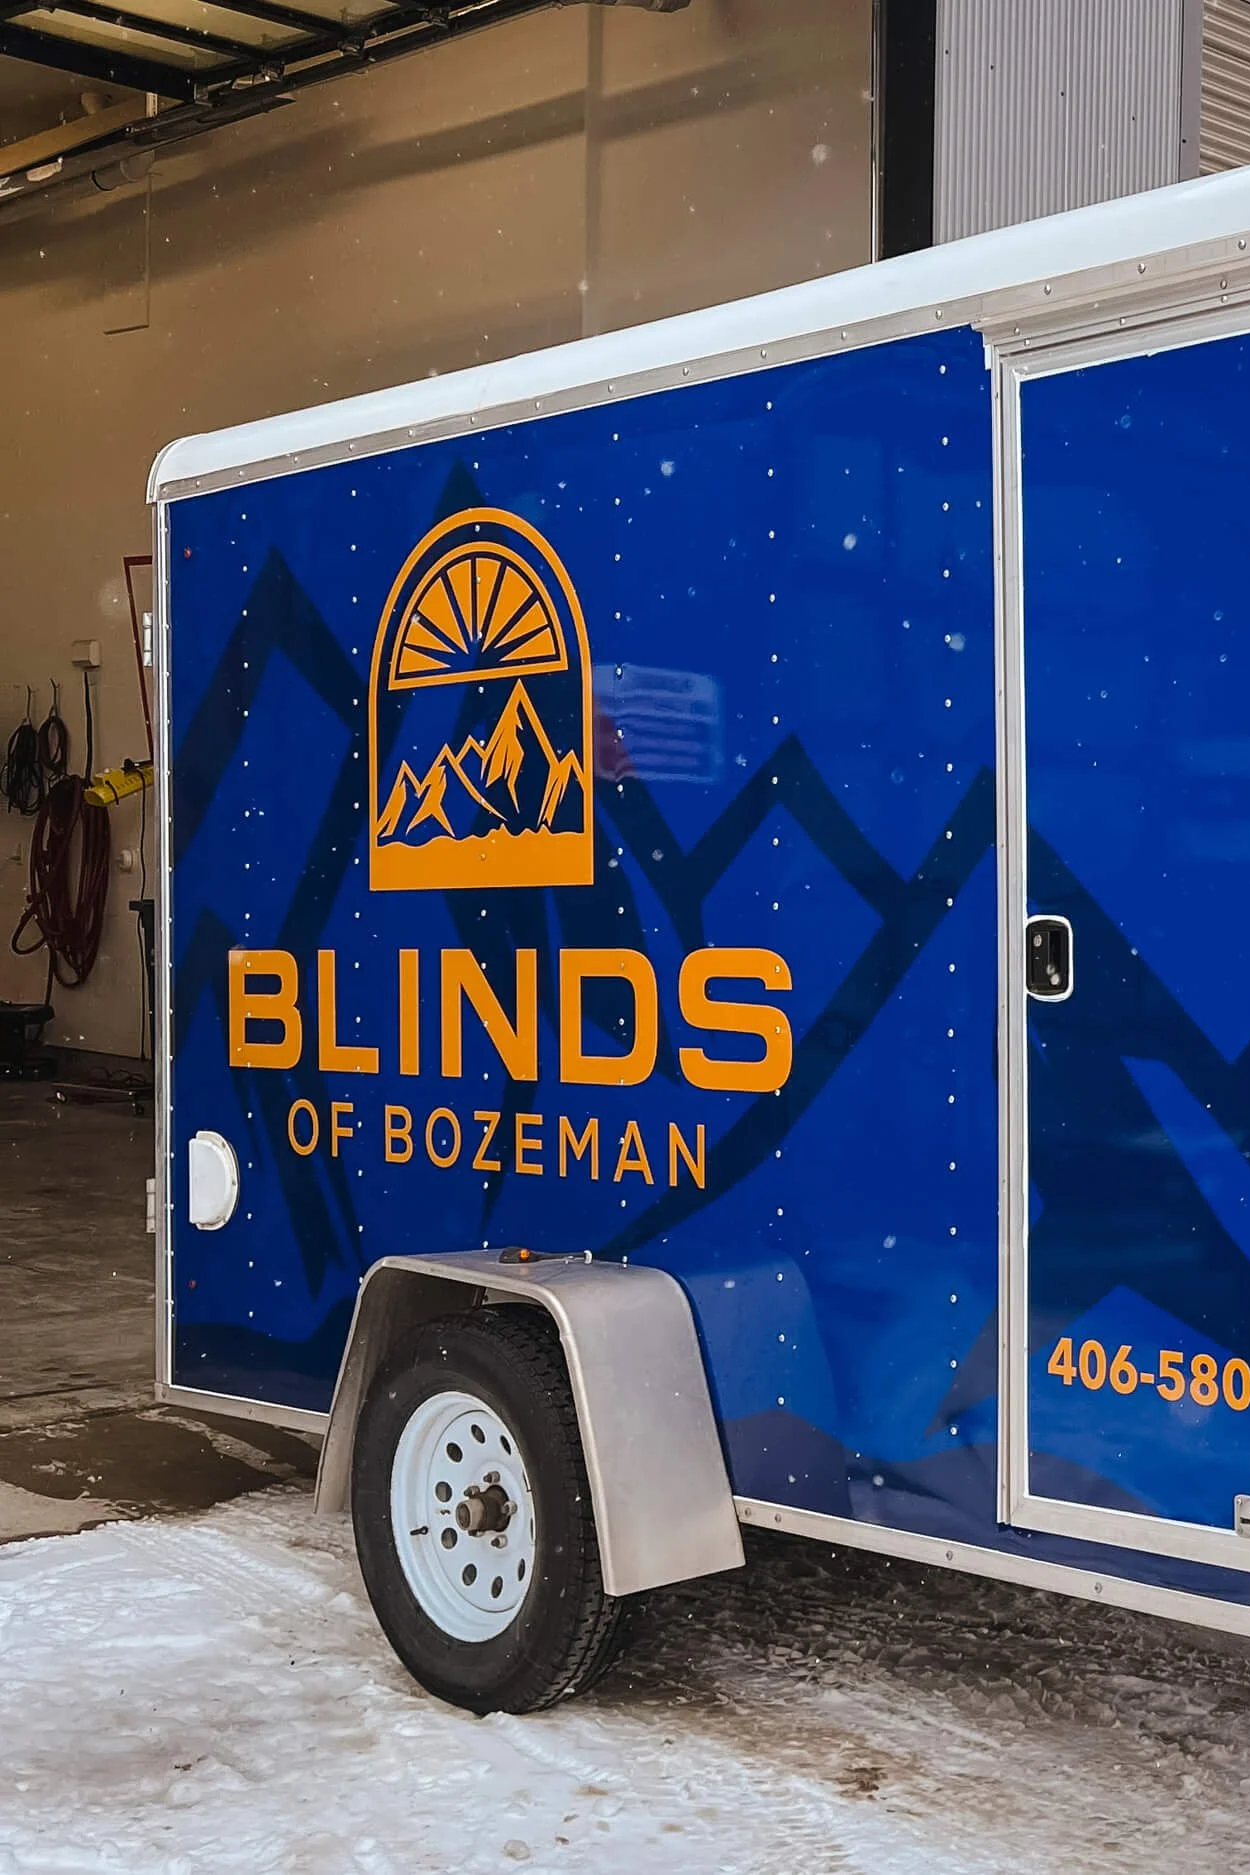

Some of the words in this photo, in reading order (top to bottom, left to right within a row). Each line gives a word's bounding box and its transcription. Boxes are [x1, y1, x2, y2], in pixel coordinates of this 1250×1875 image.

[228, 948, 794, 1093] BLINDS
[288, 1098, 355, 1158] OF
[384, 1104, 706, 1189] BOZEMAN
